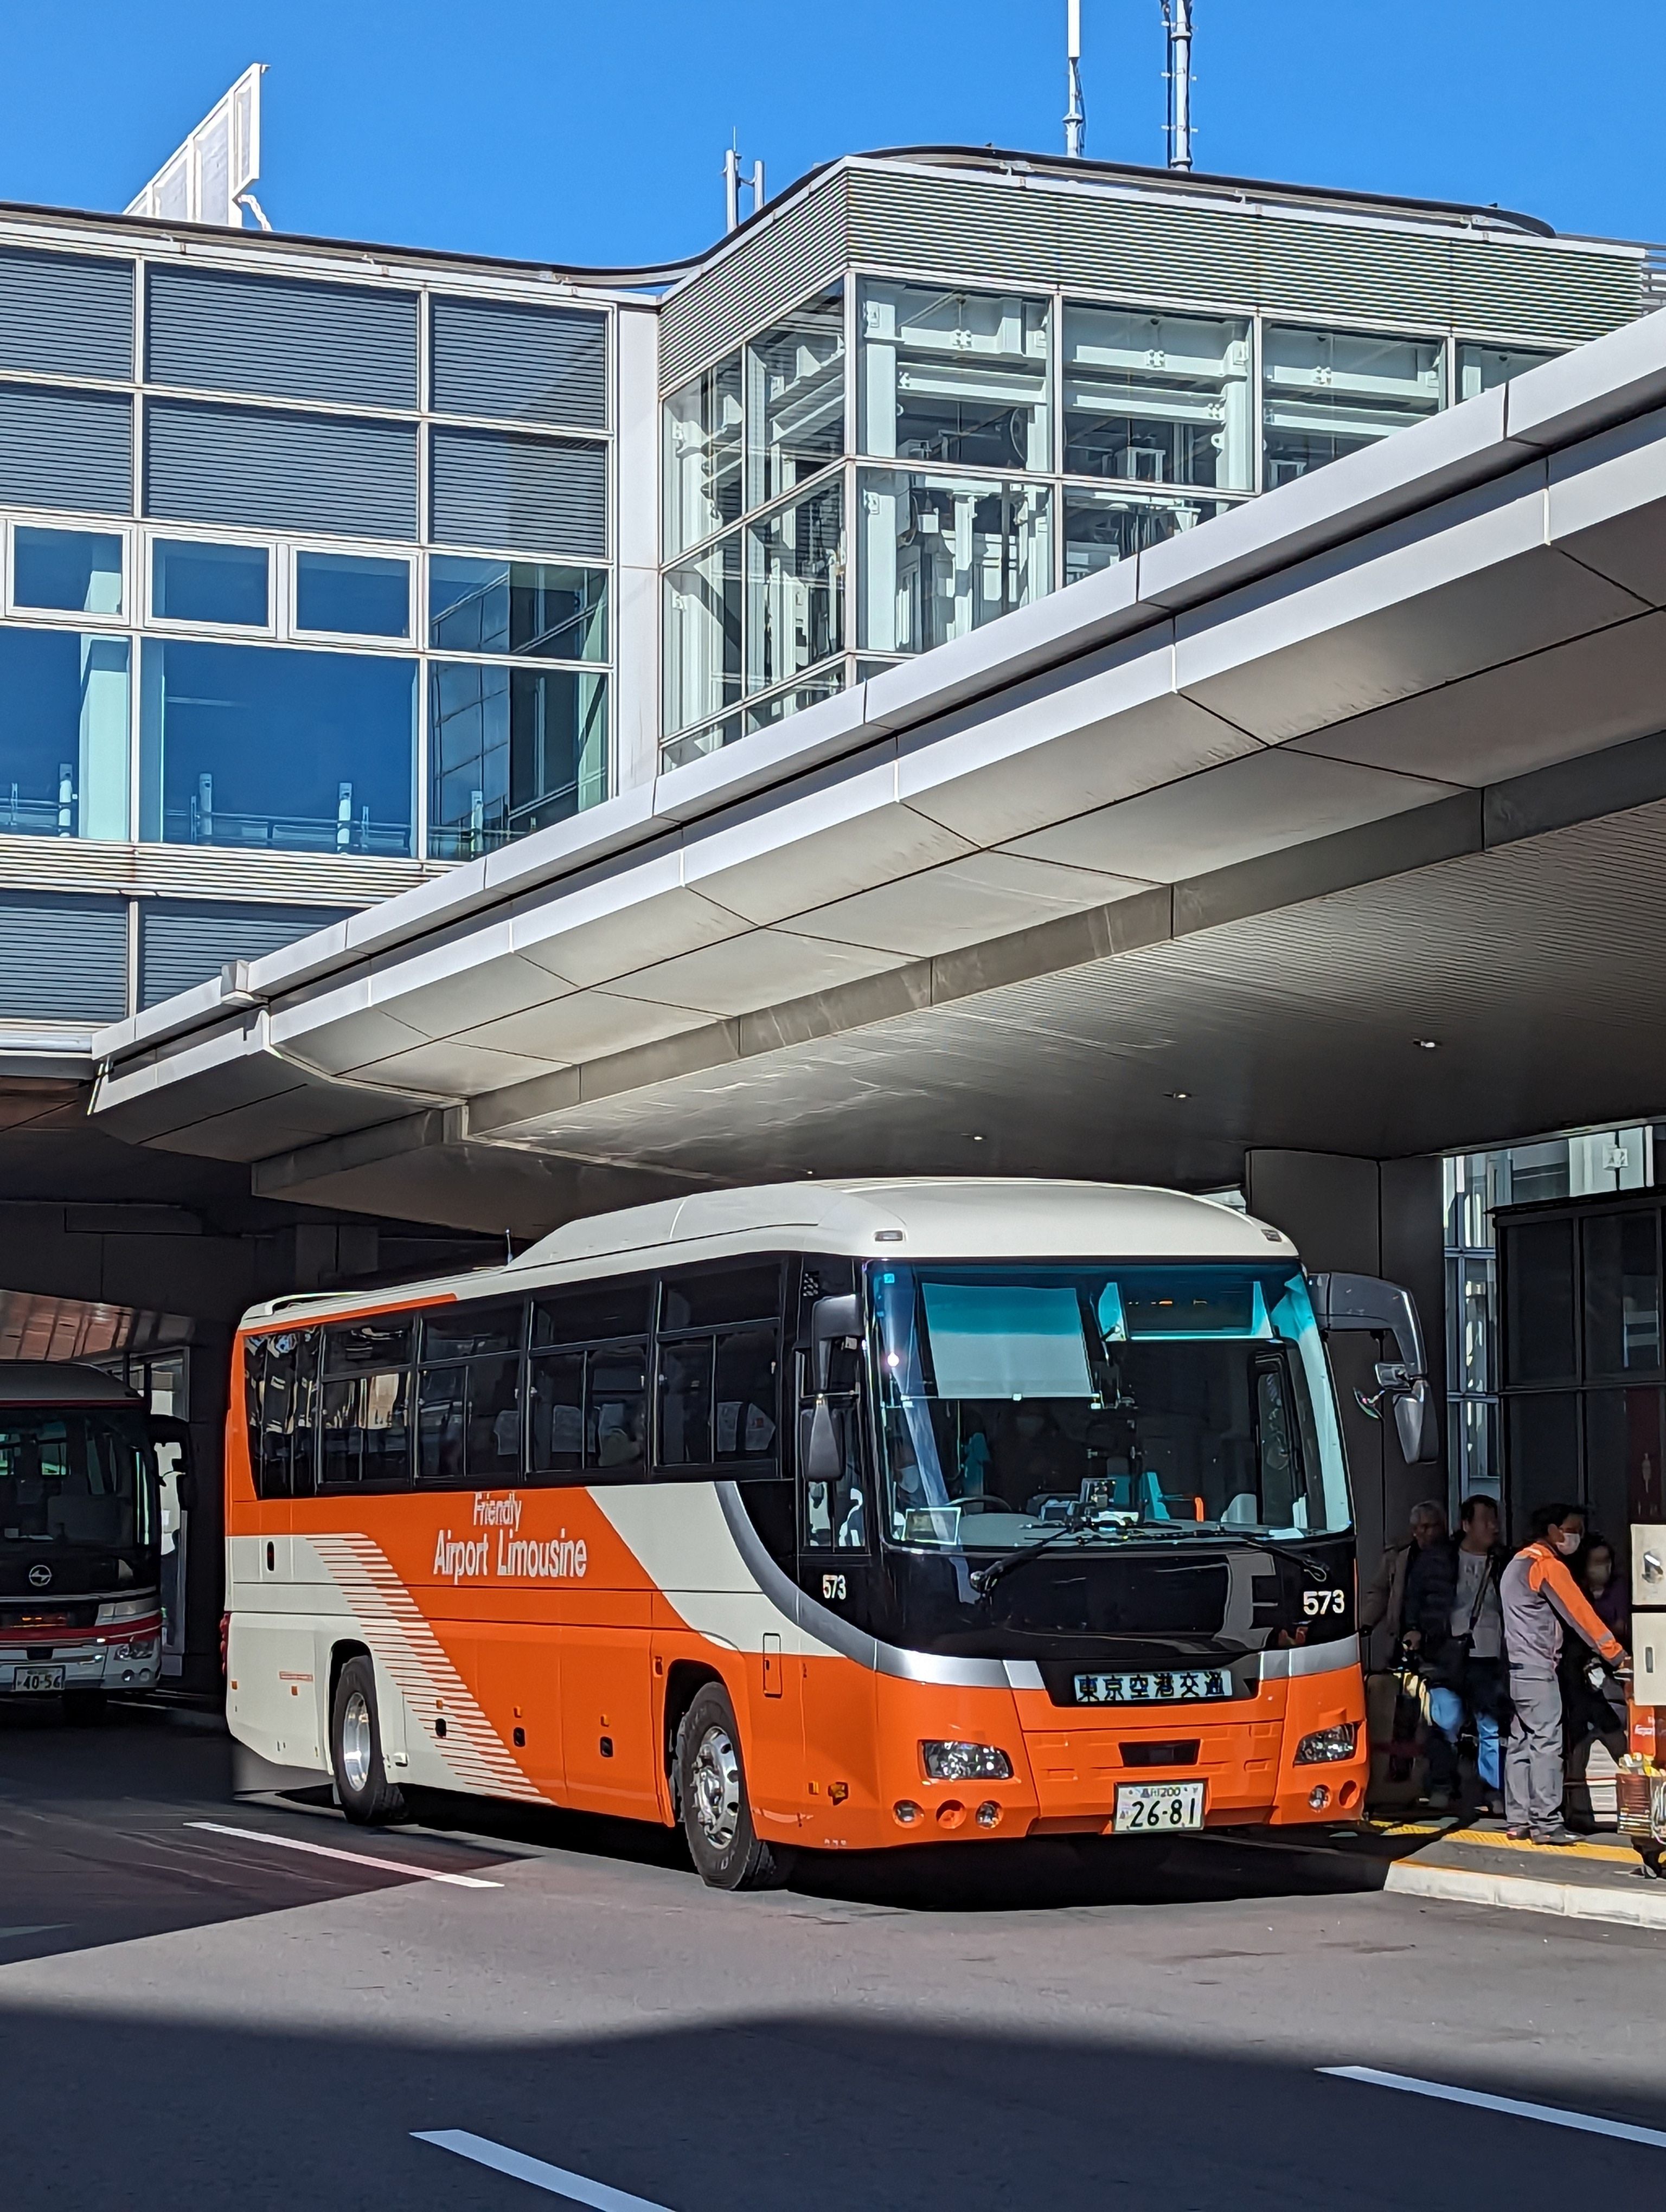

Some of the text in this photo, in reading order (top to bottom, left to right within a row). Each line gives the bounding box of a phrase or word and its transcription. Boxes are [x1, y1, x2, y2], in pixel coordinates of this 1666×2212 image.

[473, 1491, 522, 1532] Friendly
[433, 1528, 587, 1585] Airport Limousine
[823, 1574, 846, 1600] 573
[1303, 1589, 1345, 1615] 573
[1078, 1671, 1225, 1701] 東京空港交通
[1130, 1797, 1196, 1828] 26-81
